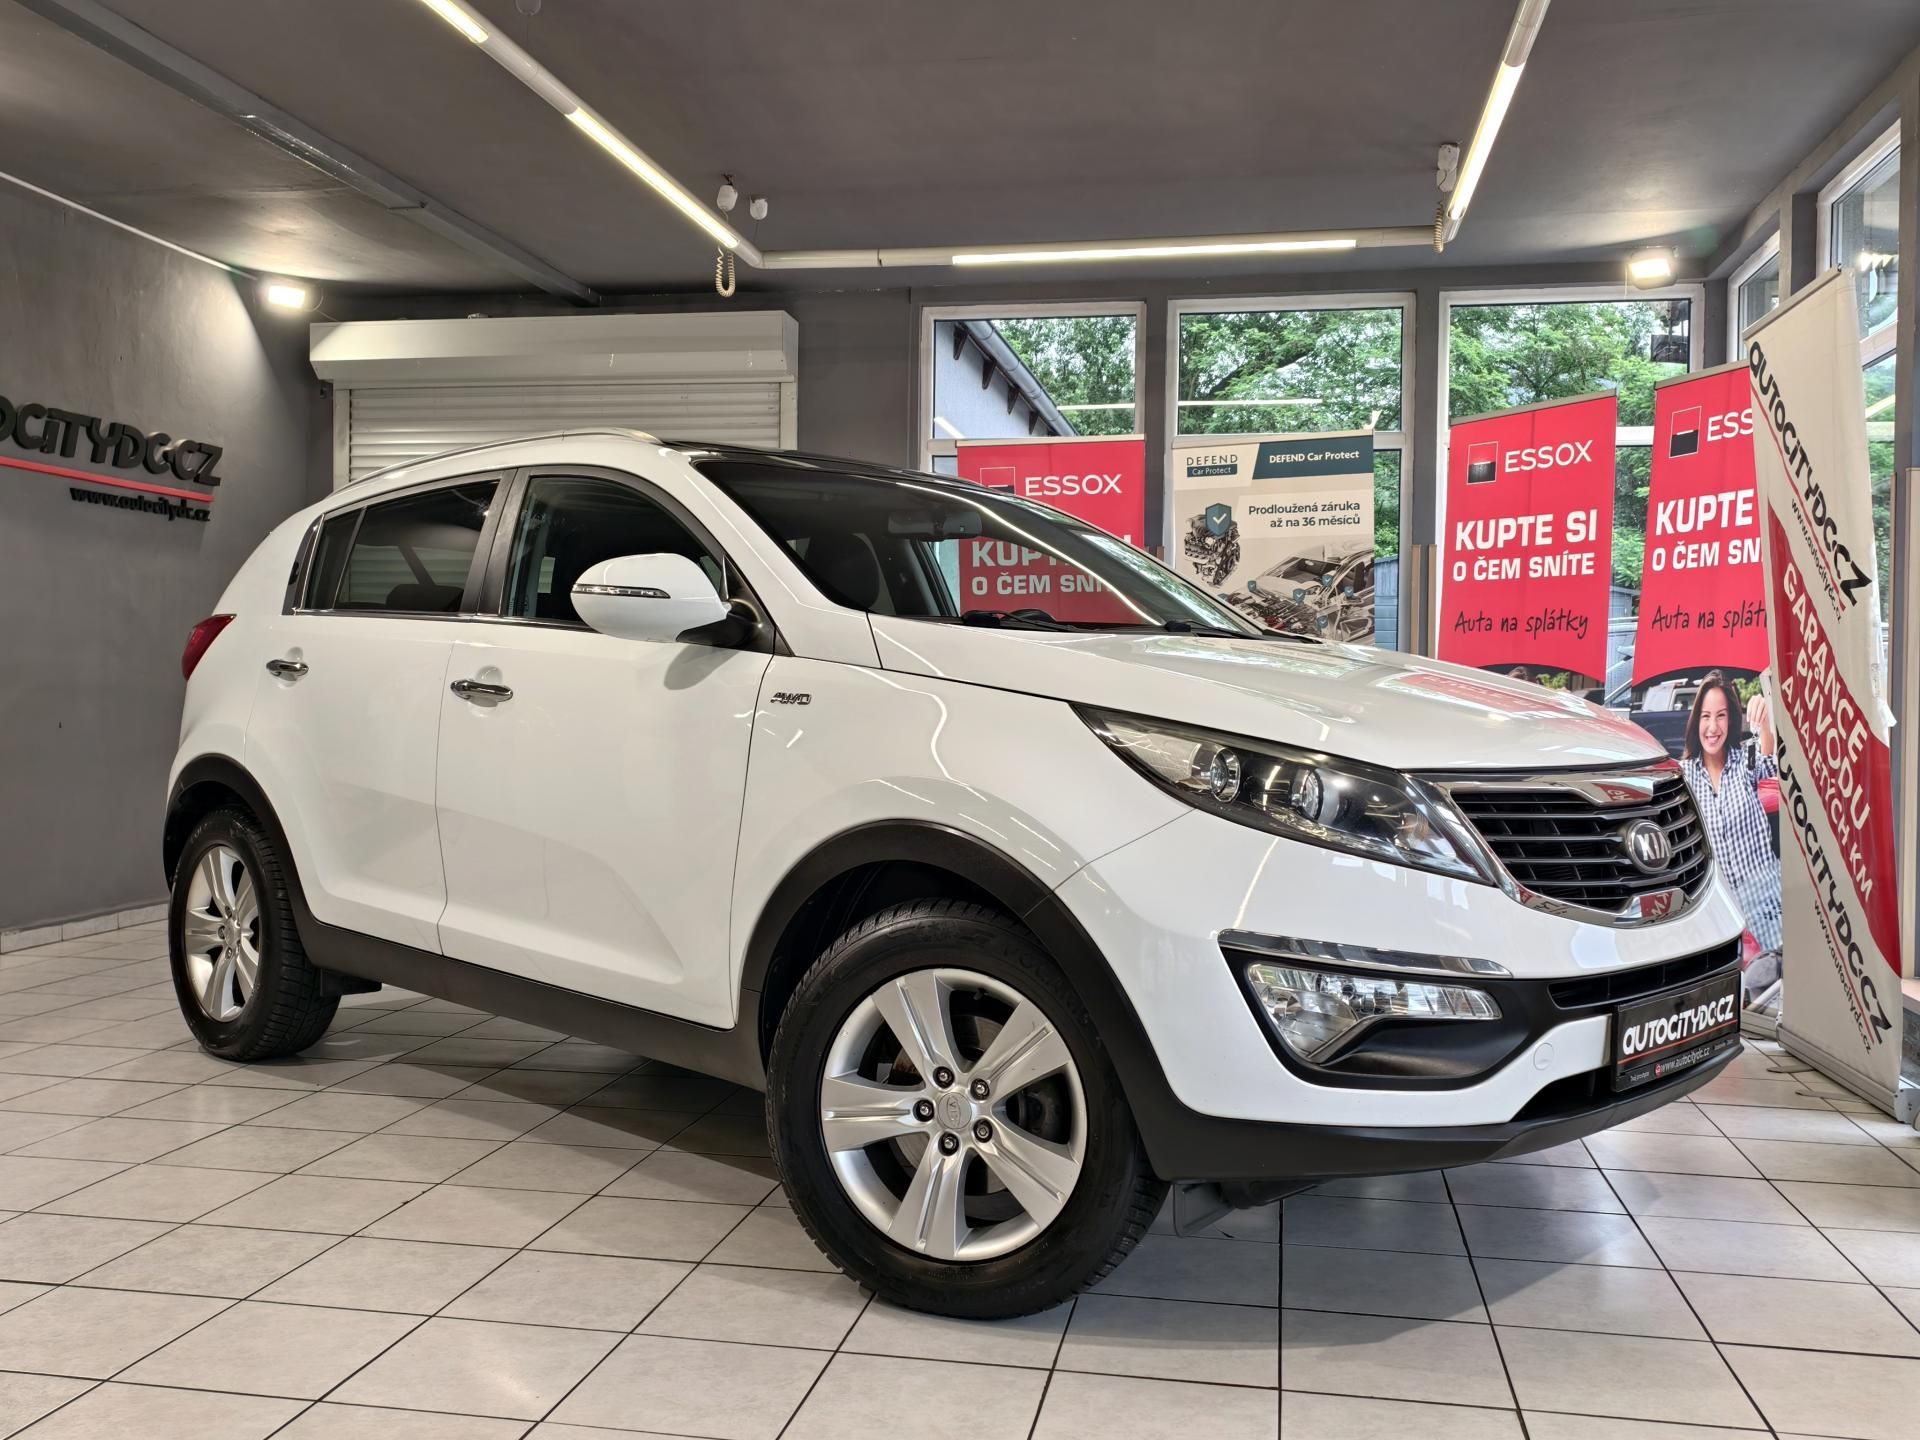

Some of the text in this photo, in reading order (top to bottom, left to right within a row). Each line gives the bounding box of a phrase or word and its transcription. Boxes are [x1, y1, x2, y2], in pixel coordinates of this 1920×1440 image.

[1707, 408, 1753, 442] ESS
[1186, 454, 1239, 466] DEFEND
[1192, 466, 1232, 476] Car Protect
[1269, 450, 1360, 463] DEFEND Car Protect
[1504, 440, 1593, 473] ESSOX
[1025, 473, 1122, 497] ESSOX
[1248, 500, 1361, 515] Prodloužená záruka
[1270, 514, 1361, 528] až na 36 měsíců
[1655, 489, 1754, 536] KUPTE
[1455, 509, 1598, 551] KUPTE SI
[972, 541, 1068, 568] KUP
[1453, 550, 1595, 582] O ČEM SNÍTE
[1652, 537, 1764, 571] O ČEM SN
[972, 576, 988, 595] O
[997, 572, 1050, 595] ČEM
[1454, 607, 1589, 641] Auta na splátky
[1650, 599, 1767, 638] Auta na splát
[1783, 562, 1868, 763] GARANCE
[770, 692, 812, 706] AWD
[1796, 647, 1871, 831] PŮVODU
[1782, 676, 1873, 903] A NAJETÝCH KM
[1636, 831, 1670, 861] KIA
